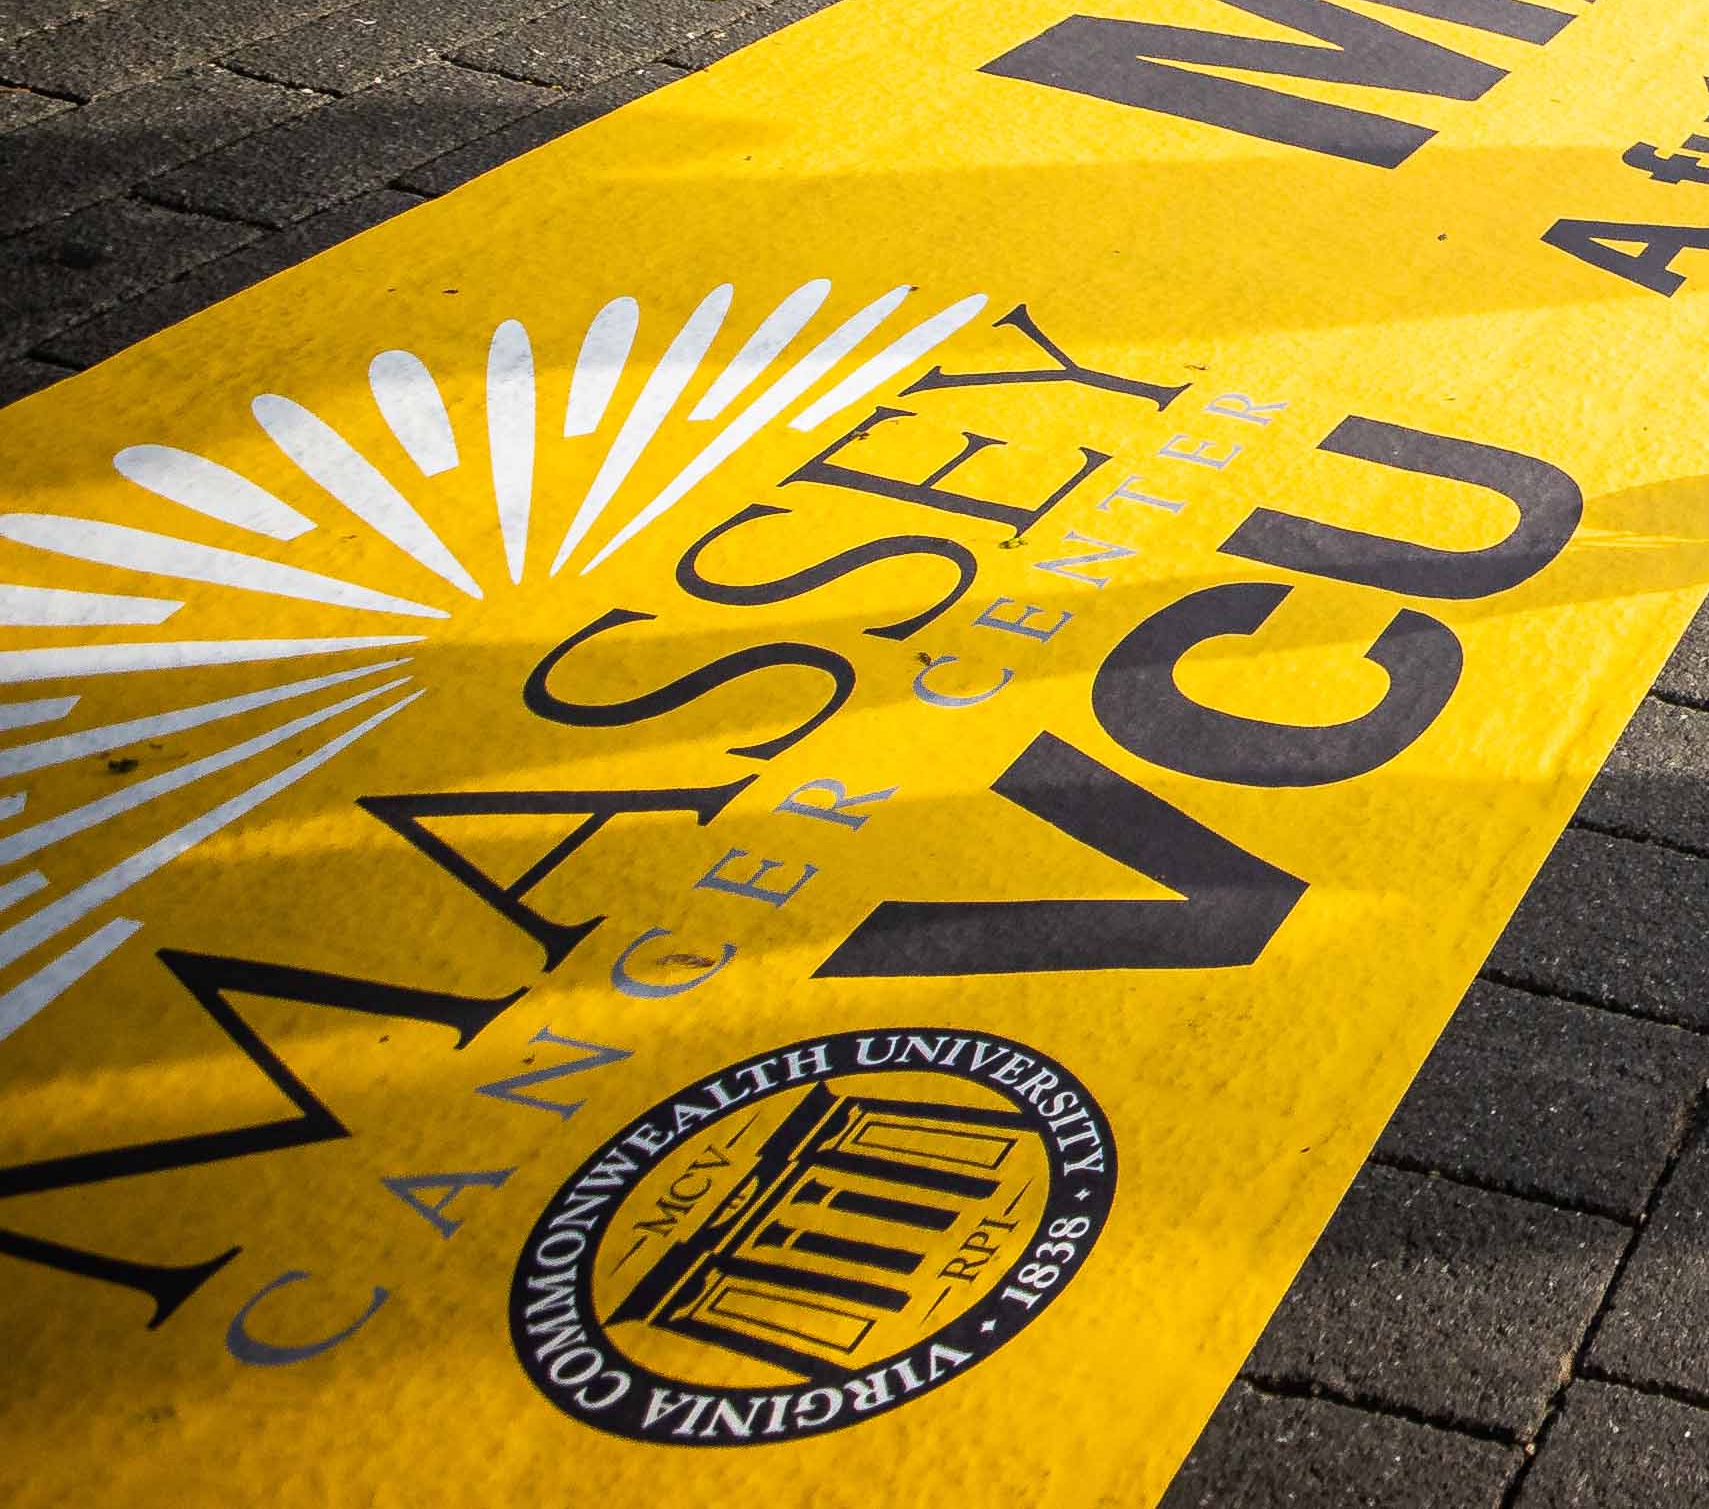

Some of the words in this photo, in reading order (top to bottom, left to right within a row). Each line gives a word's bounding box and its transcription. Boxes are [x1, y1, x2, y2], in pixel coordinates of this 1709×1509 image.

[809, 414, 1584, 980] VCU
[0, 303, 1193, 1330] MASSEY
[225, 776, 901, 1367] CANCER
[912, 392, 1289, 709] CENTER
[855, 1033, 1106, 1179] UNIVERSITY
[524, 1043, 834, 1412] COMMONWEALTH
[632, 1145, 732, 1239] MCV
[940, 1215, 1021, 1286] RPI
[1001, 1213, 1092, 1312] 1838
[643, 1344, 973, 1438] VIRGINIA
